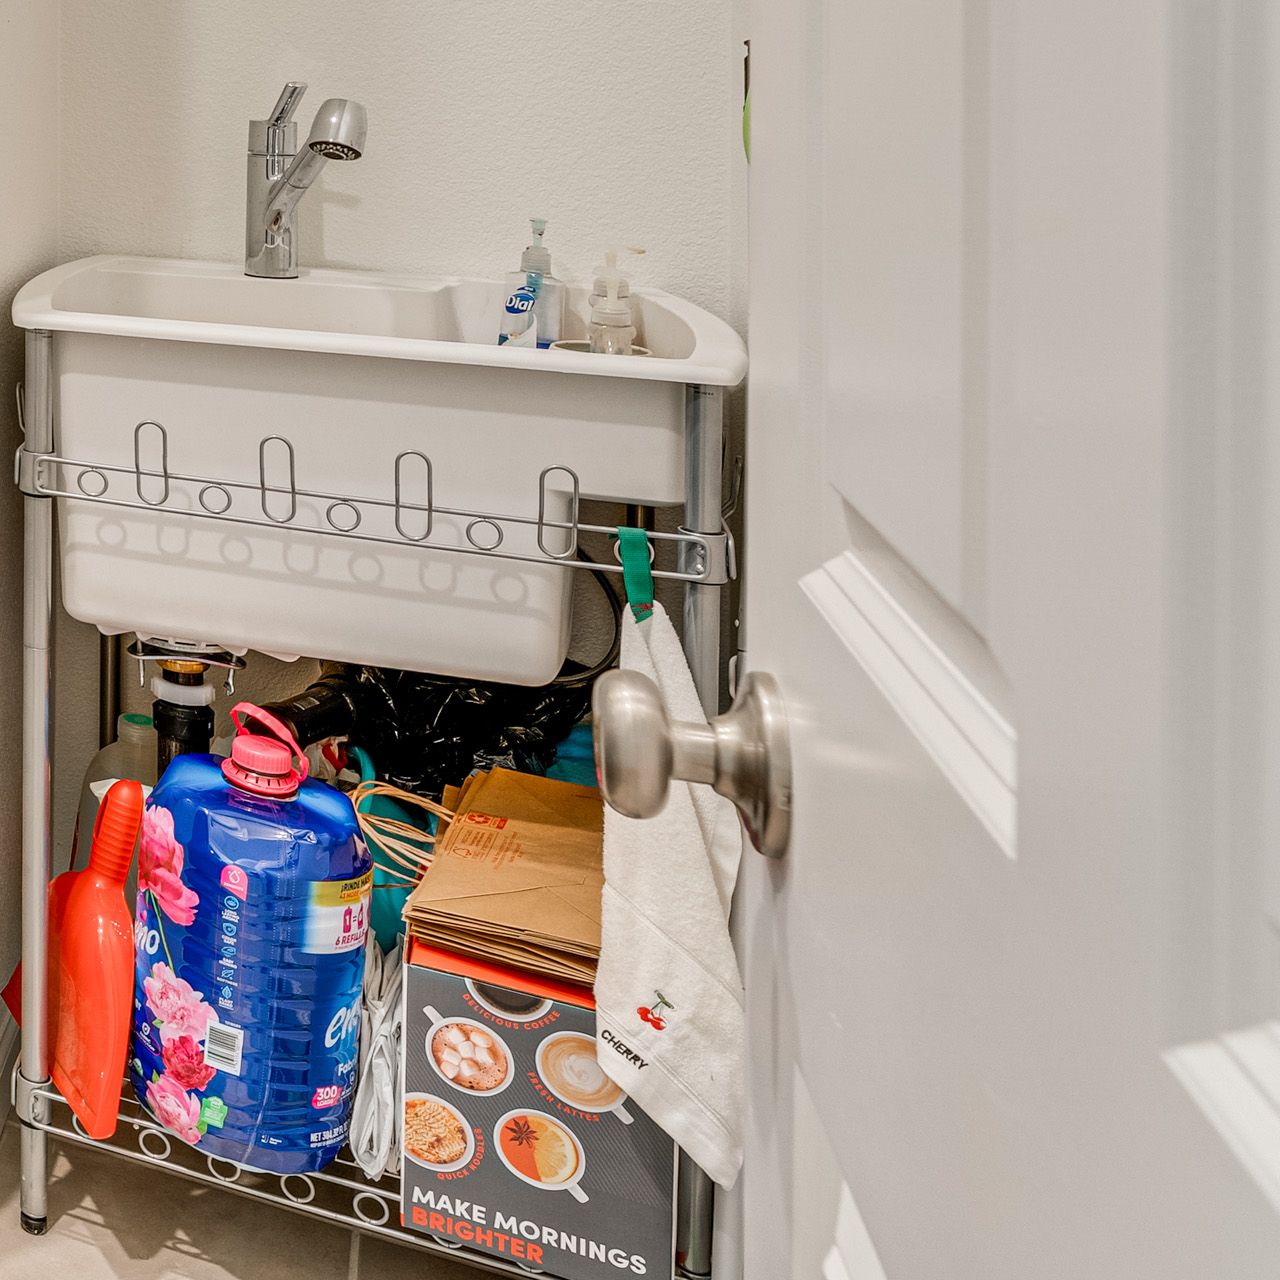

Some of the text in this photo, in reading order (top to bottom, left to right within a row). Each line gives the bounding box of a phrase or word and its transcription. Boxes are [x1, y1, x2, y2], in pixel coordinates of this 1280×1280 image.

[506, 296, 535, 312] Dial
[335, 929, 365, 946] 6 REFILLS
[462, 993, 561, 1031] DELICIOUS COFFEE
[601, 1029, 649, 1070] CHERRY
[317, 1086, 338, 1101] 300
[528, 1071, 600, 1122] FRESH LATTES
[310, 1132, 323, 1142] NET
[437, 1127, 485, 1181] QUICK NOODLES
[411, 1206, 544, 1265] BRIGHTER
[412, 1186, 647, 1275] MAKE MORNINGS
